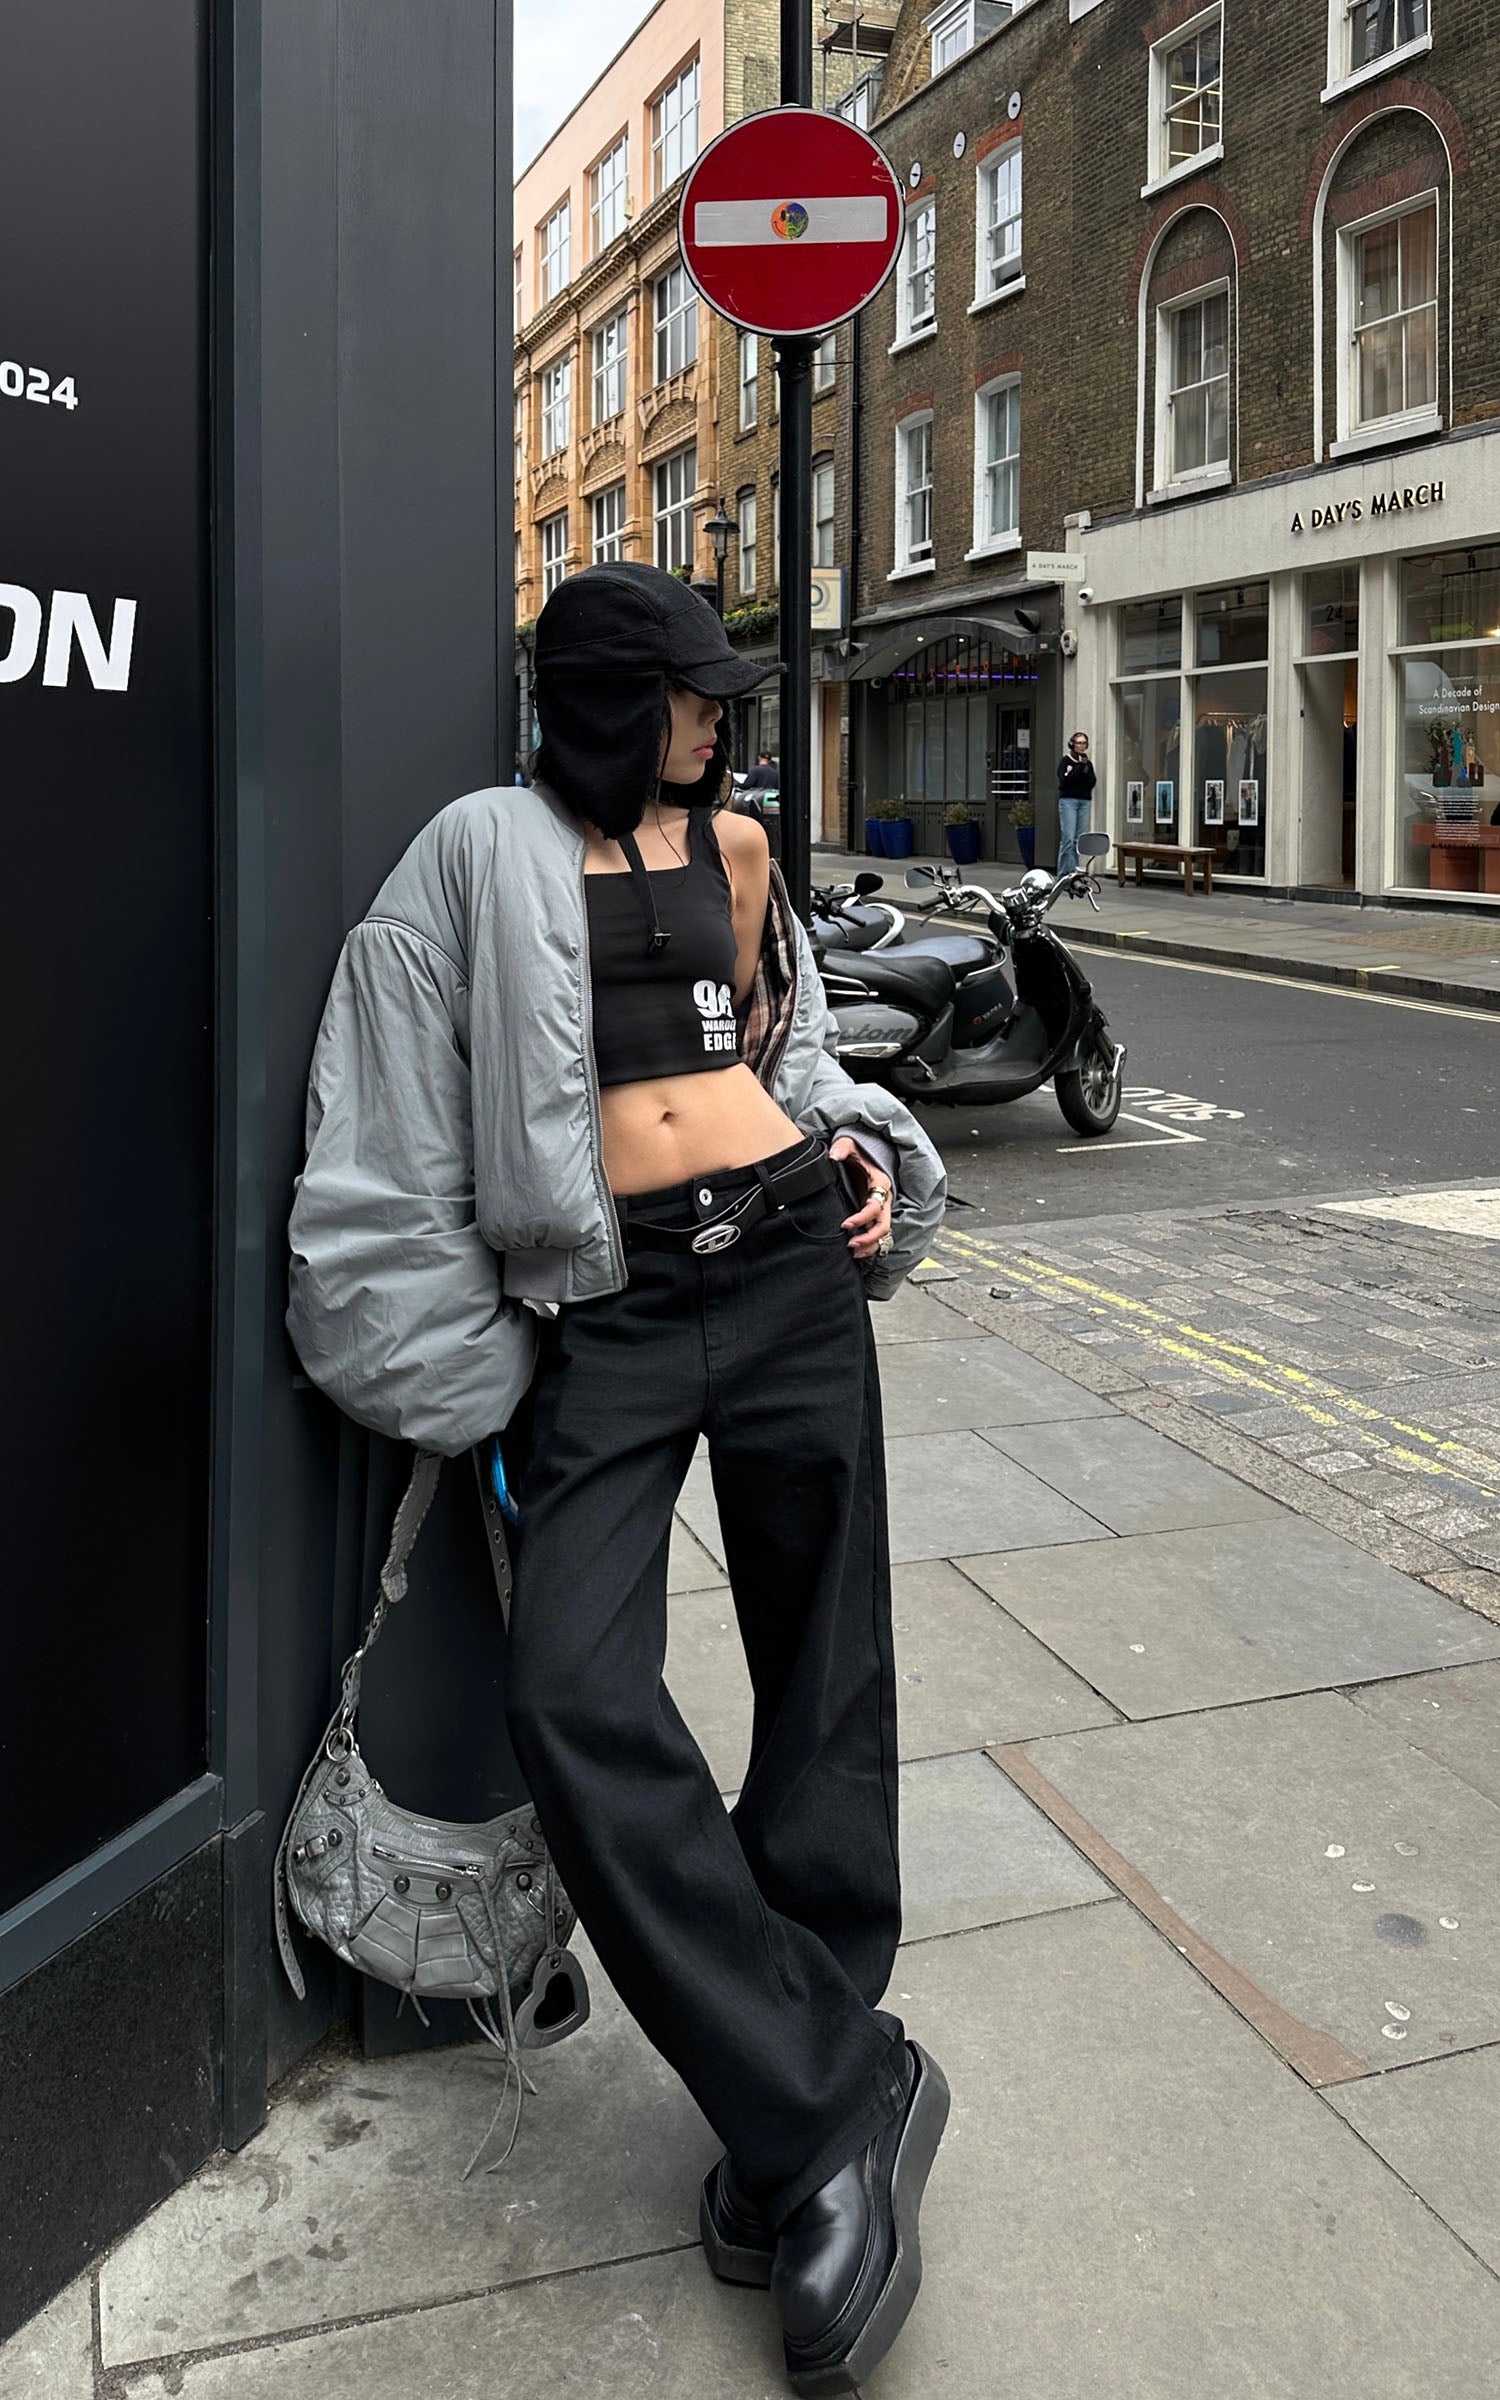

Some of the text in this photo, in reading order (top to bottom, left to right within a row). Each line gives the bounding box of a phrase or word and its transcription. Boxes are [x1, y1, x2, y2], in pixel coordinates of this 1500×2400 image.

[1290, 481, 1445, 532] A DAY'S MARCH
[1326, 604, 1344, 622] 24
[1433, 685, 1483, 699] A Decade of
[1419, 701, 1500, 715] Scandinavian Design
